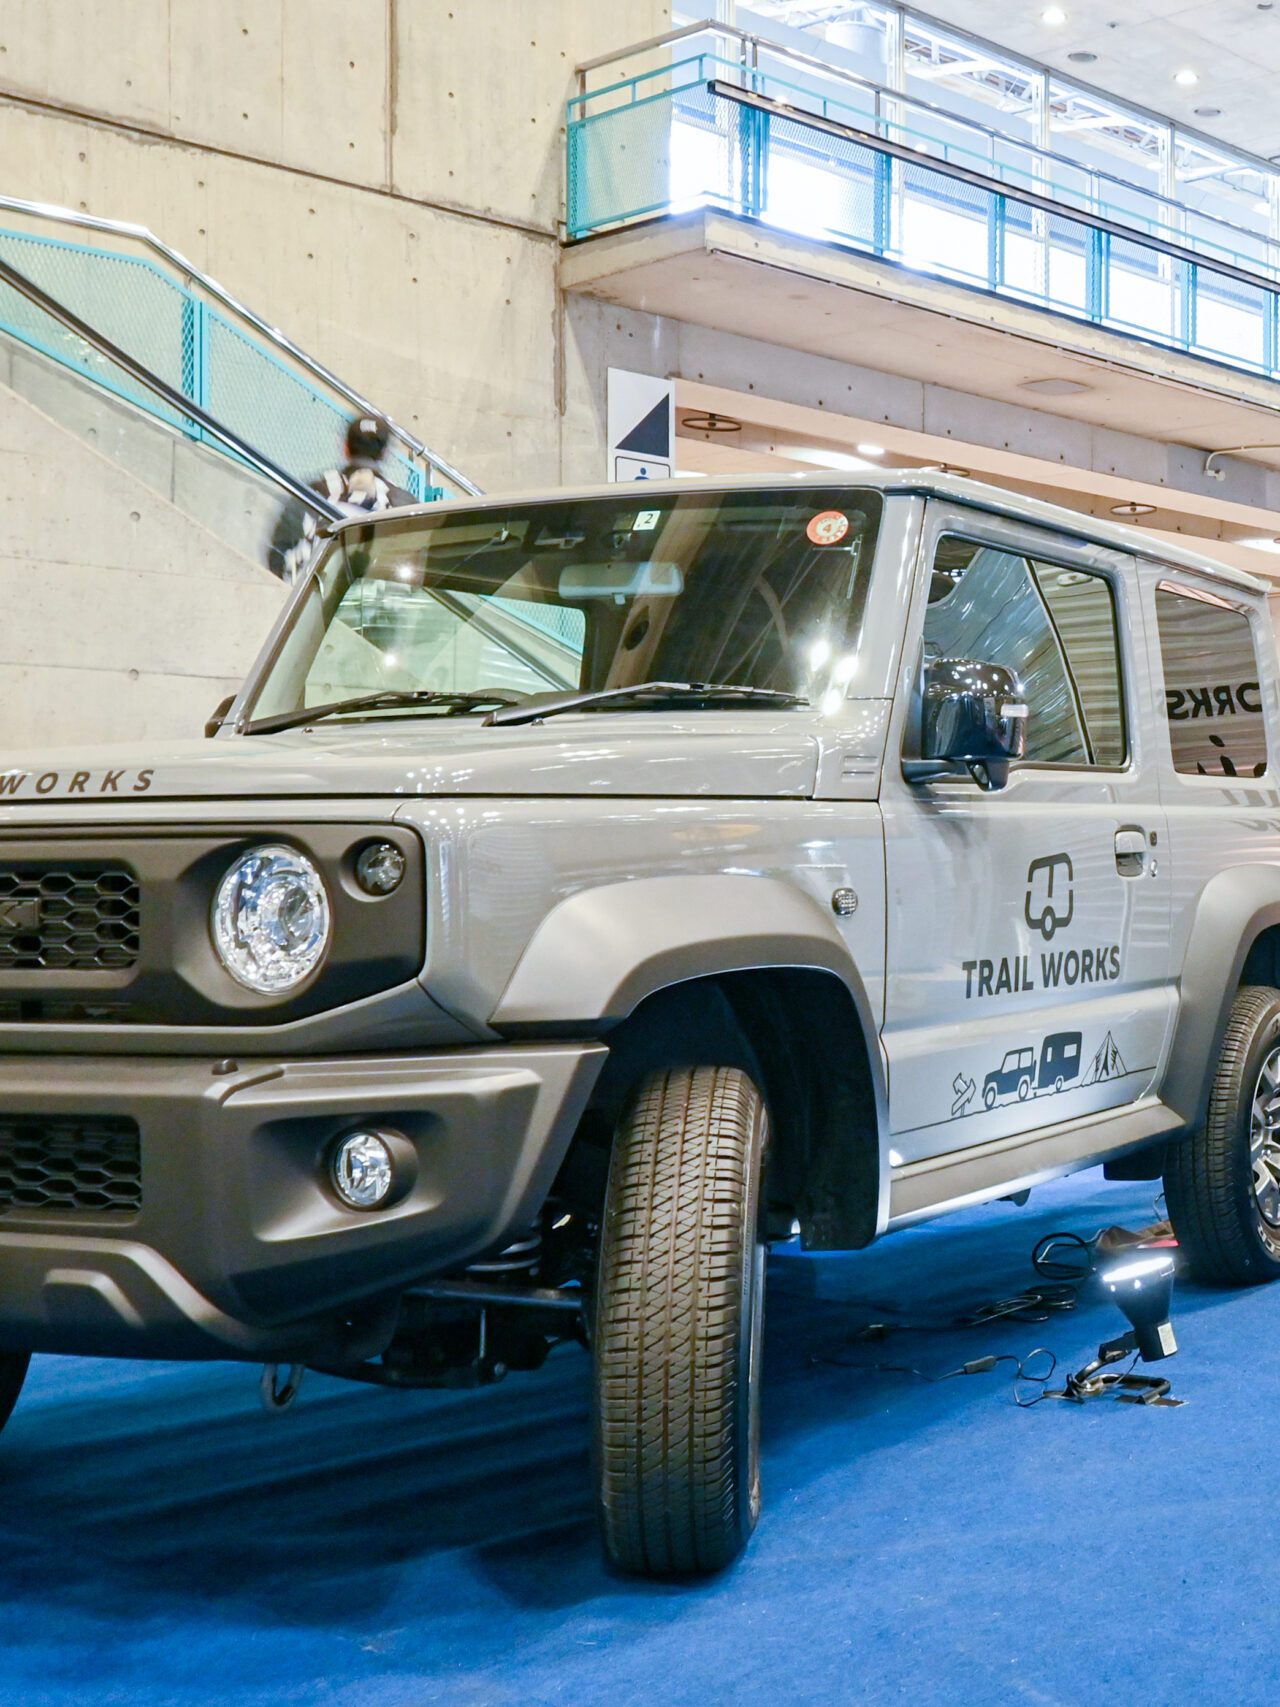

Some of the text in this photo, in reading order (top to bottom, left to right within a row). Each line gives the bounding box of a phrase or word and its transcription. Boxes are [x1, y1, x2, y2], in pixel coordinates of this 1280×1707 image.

[644, 513, 654, 524] 2
[822, 523, 832, 533] 4
[0, 769, 155, 795] WORKS
[962, 945, 1121, 999] TRAIL WORKS
